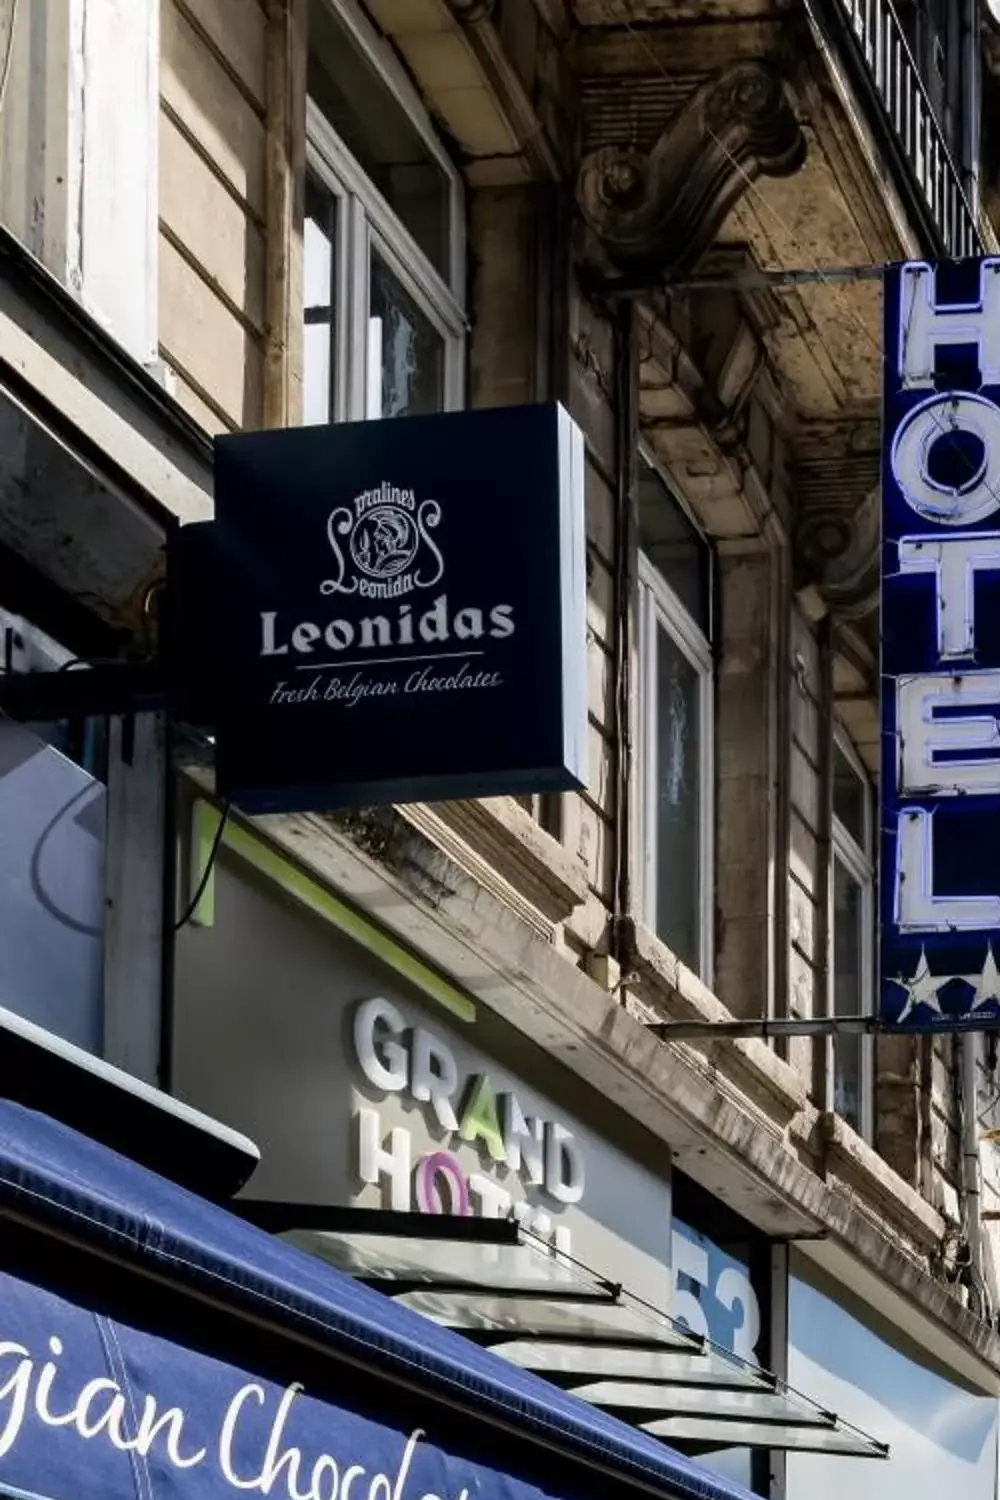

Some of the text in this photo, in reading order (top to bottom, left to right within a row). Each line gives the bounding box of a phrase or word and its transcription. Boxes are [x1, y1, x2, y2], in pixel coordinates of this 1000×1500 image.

[353, 480, 416, 516] pralines
[259, 594, 516, 656] Leonidas
[269, 662, 504, 708] Fresh Belgian Chocolates
[354, 998, 585, 1203] GRAND
